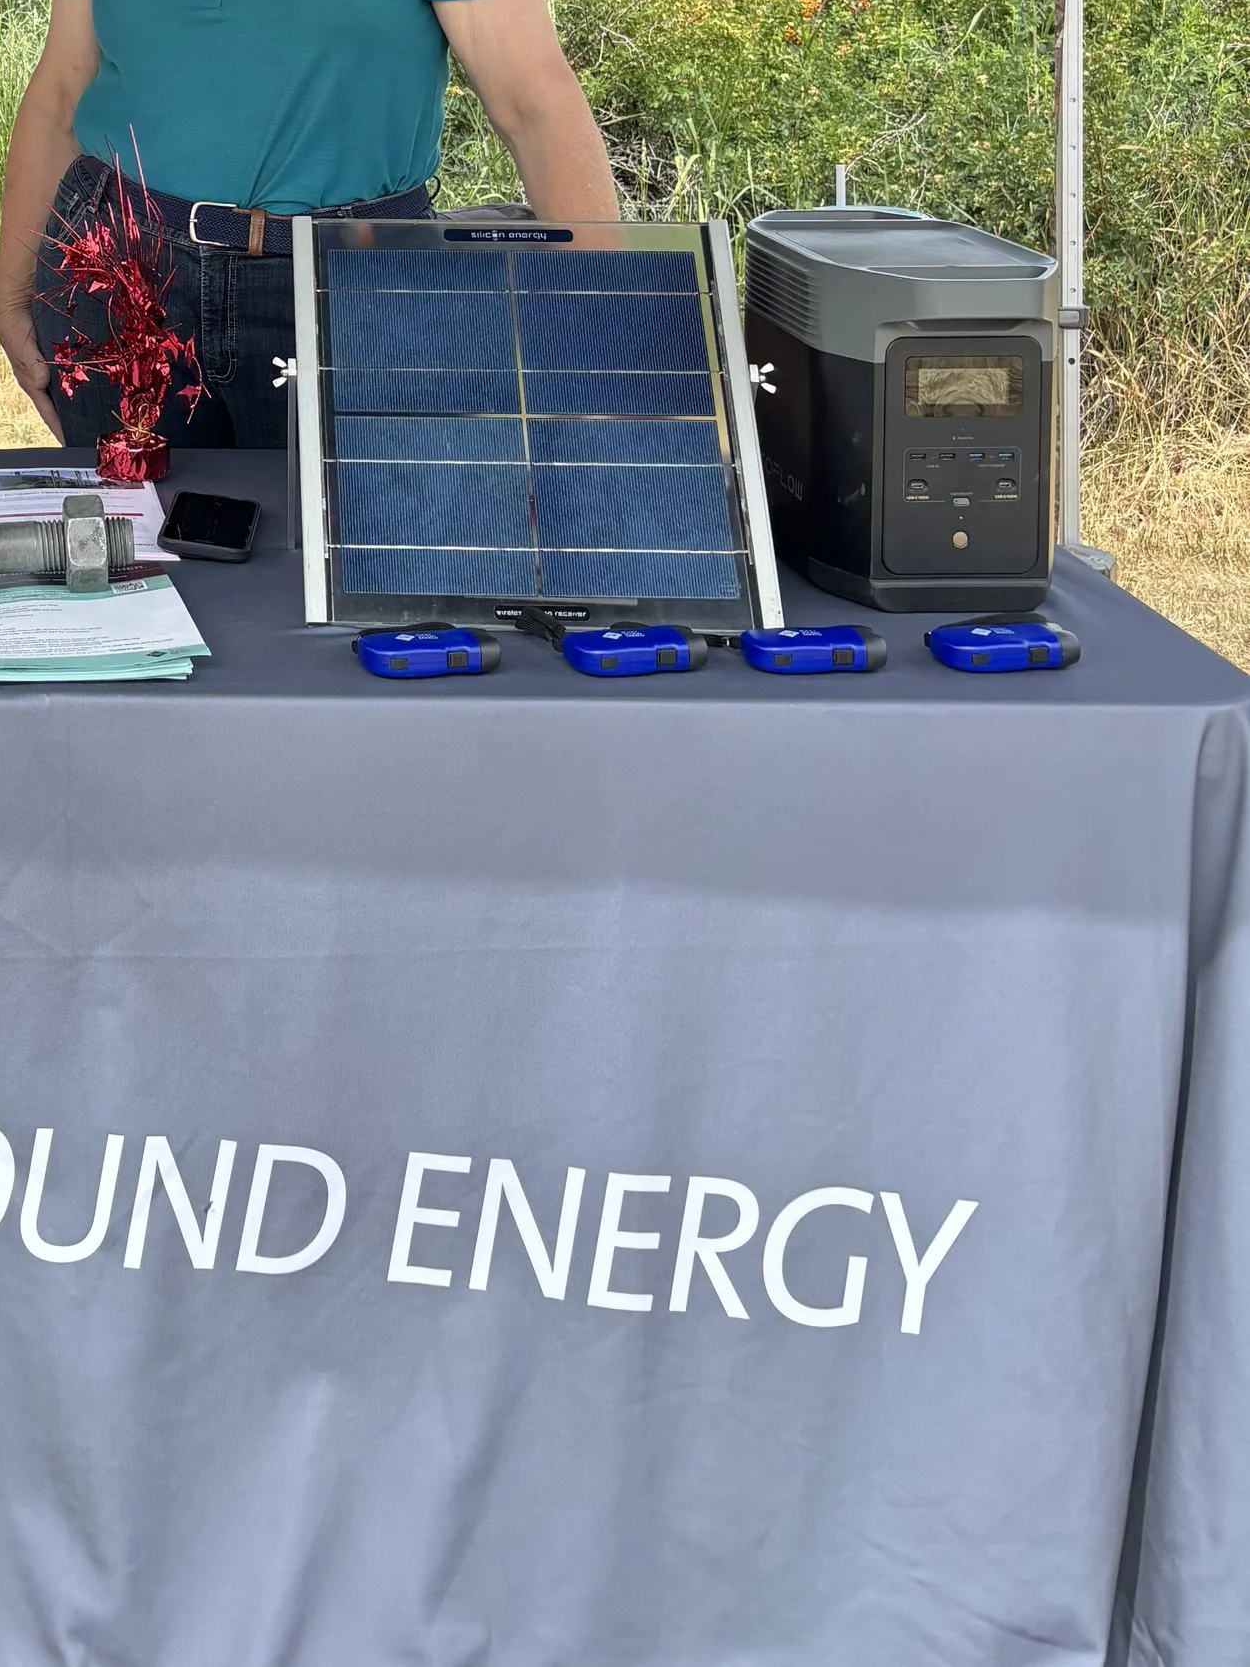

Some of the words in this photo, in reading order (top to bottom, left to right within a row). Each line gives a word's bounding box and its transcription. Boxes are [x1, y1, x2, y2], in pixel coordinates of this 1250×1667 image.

[471, 229, 505, 240] silicon
[508, 232, 547, 240] energy
[387, 1153, 979, 1335] ENERGY
